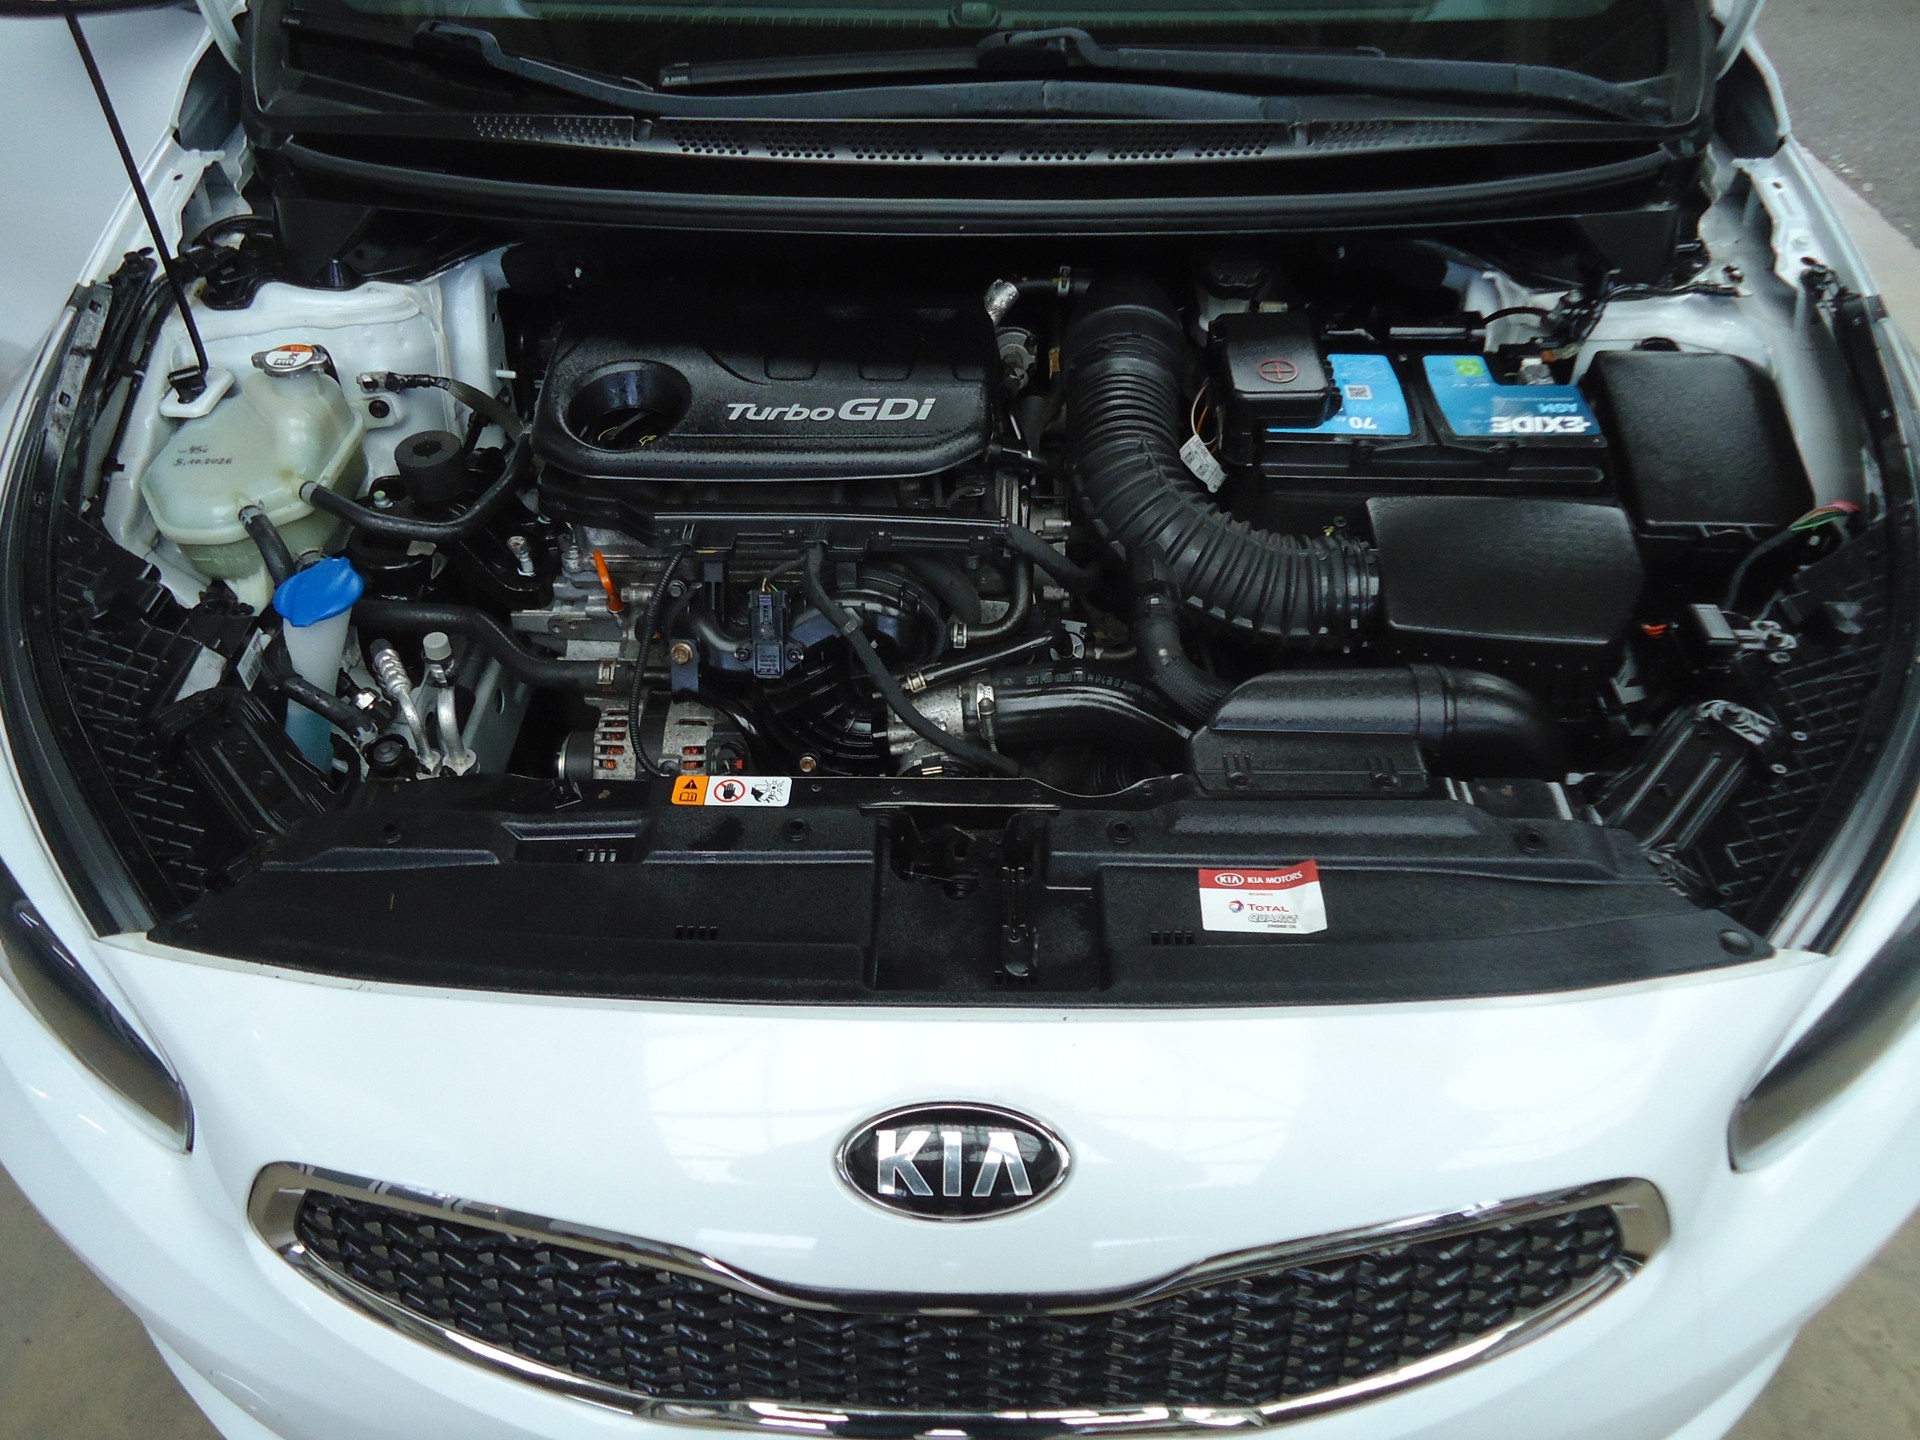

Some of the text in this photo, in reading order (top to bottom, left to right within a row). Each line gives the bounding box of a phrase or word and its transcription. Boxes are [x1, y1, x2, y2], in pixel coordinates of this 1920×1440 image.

[1347, 415, 1379, 430] 70
[1489, 415, 1592, 434] EXIDE
[1247, 871, 1303, 884] KIA MOTORS
[1248, 913, 1298, 923] QUARTZ
[876, 1130, 1033, 1197] KIA
